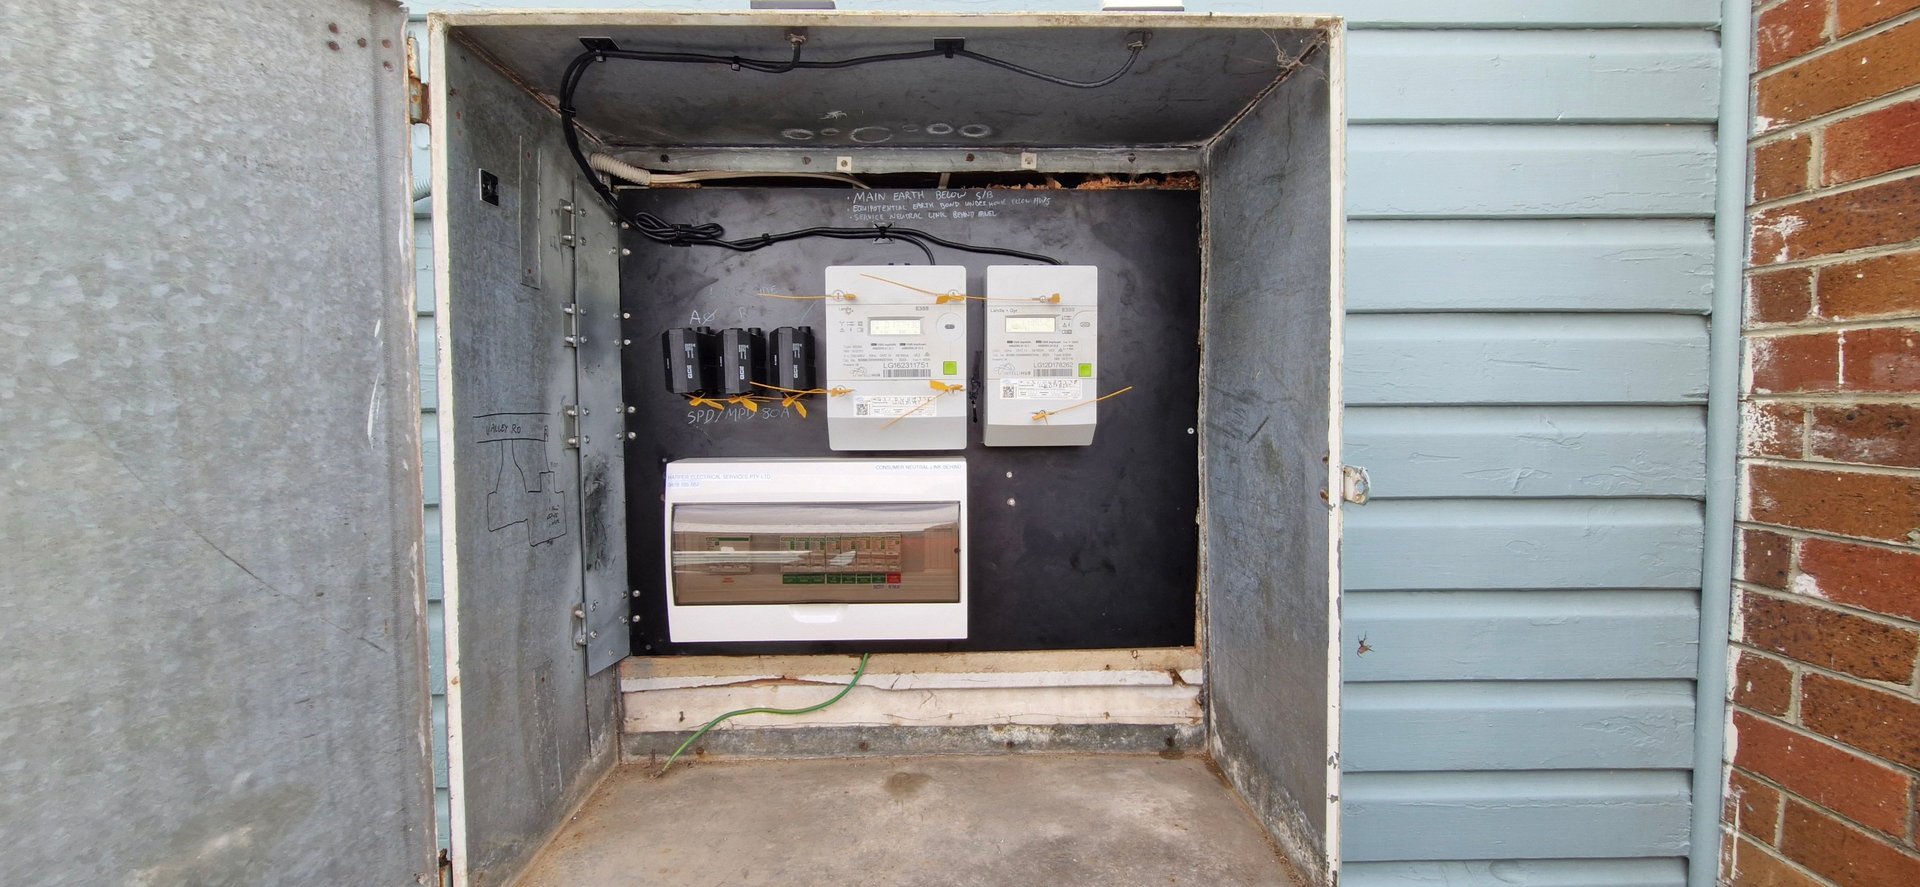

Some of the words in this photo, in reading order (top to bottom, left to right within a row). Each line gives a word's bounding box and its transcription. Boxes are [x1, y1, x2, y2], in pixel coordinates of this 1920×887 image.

[853, 192, 886, 204] MAIN
[893, 190, 925, 201] EARTH
[935, 190, 967, 200] BELOW
